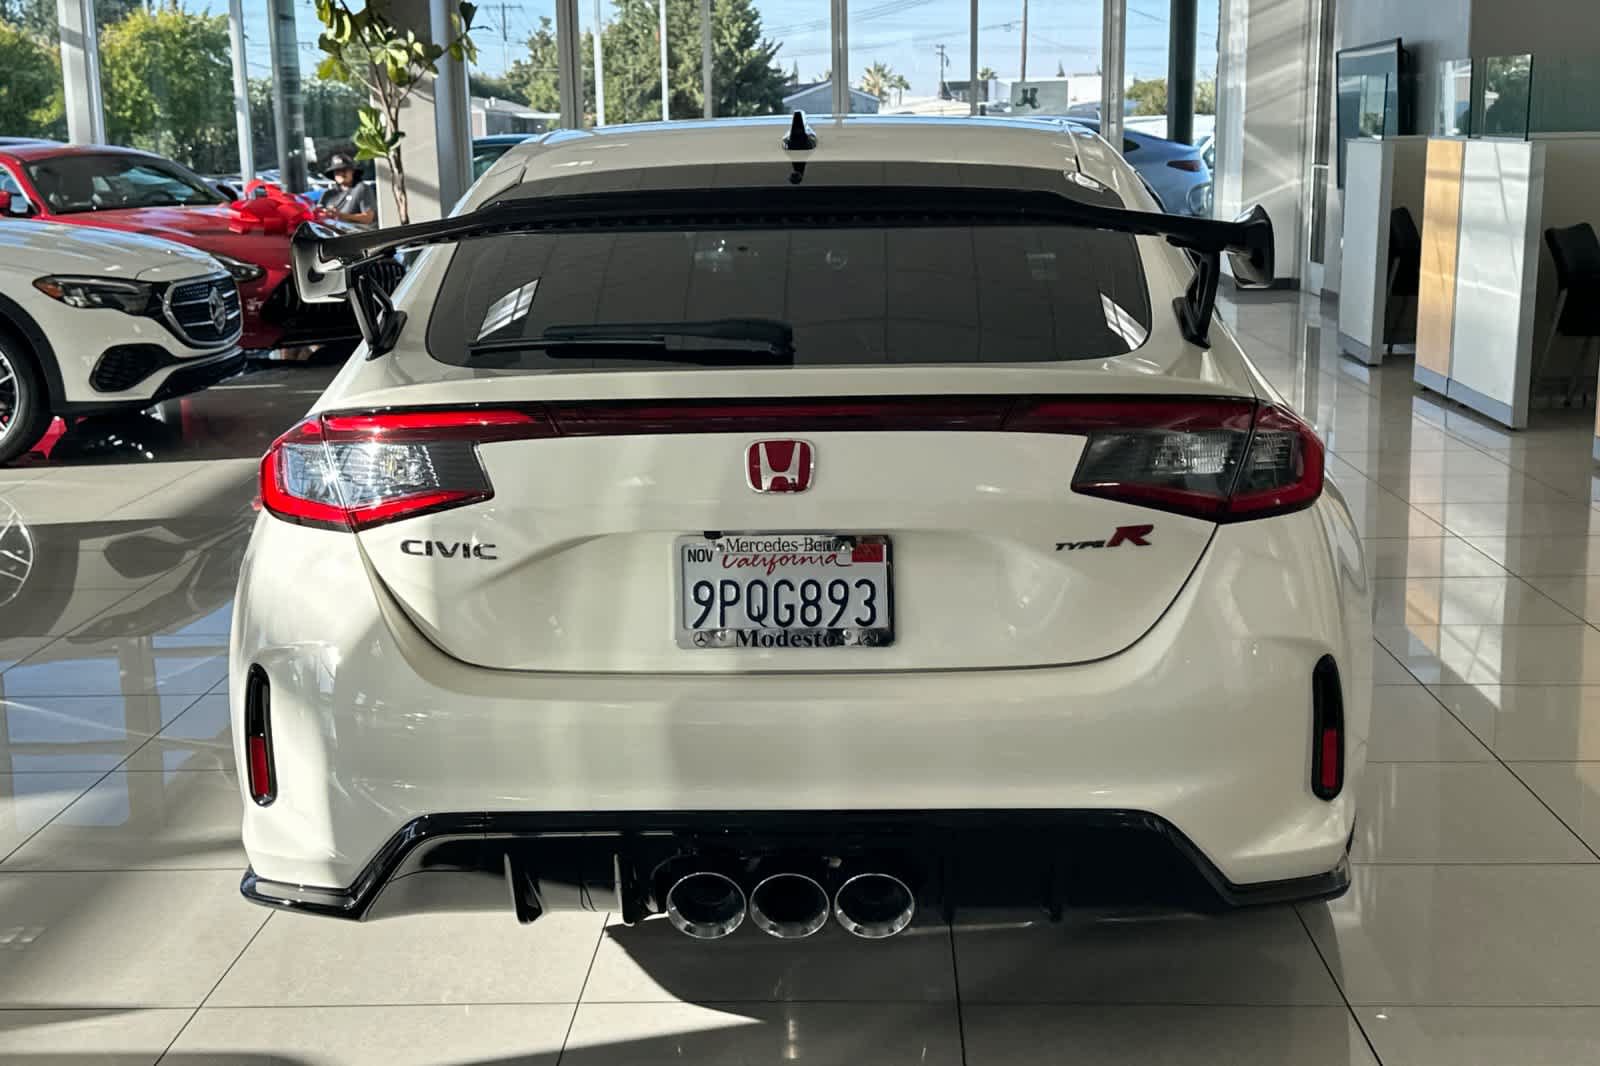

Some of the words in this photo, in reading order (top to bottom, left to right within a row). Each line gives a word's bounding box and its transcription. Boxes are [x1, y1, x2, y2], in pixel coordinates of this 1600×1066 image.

[1055, 540, 1106, 551] TYPE
[1106, 524, 1154, 548] R
[400, 539, 498, 560] CIVIC
[687, 548, 713, 562] NOV
[722, 553, 852, 576] California
[692, 578, 877, 629] 9PQG893
[736, 629, 837, 648] Modesto
